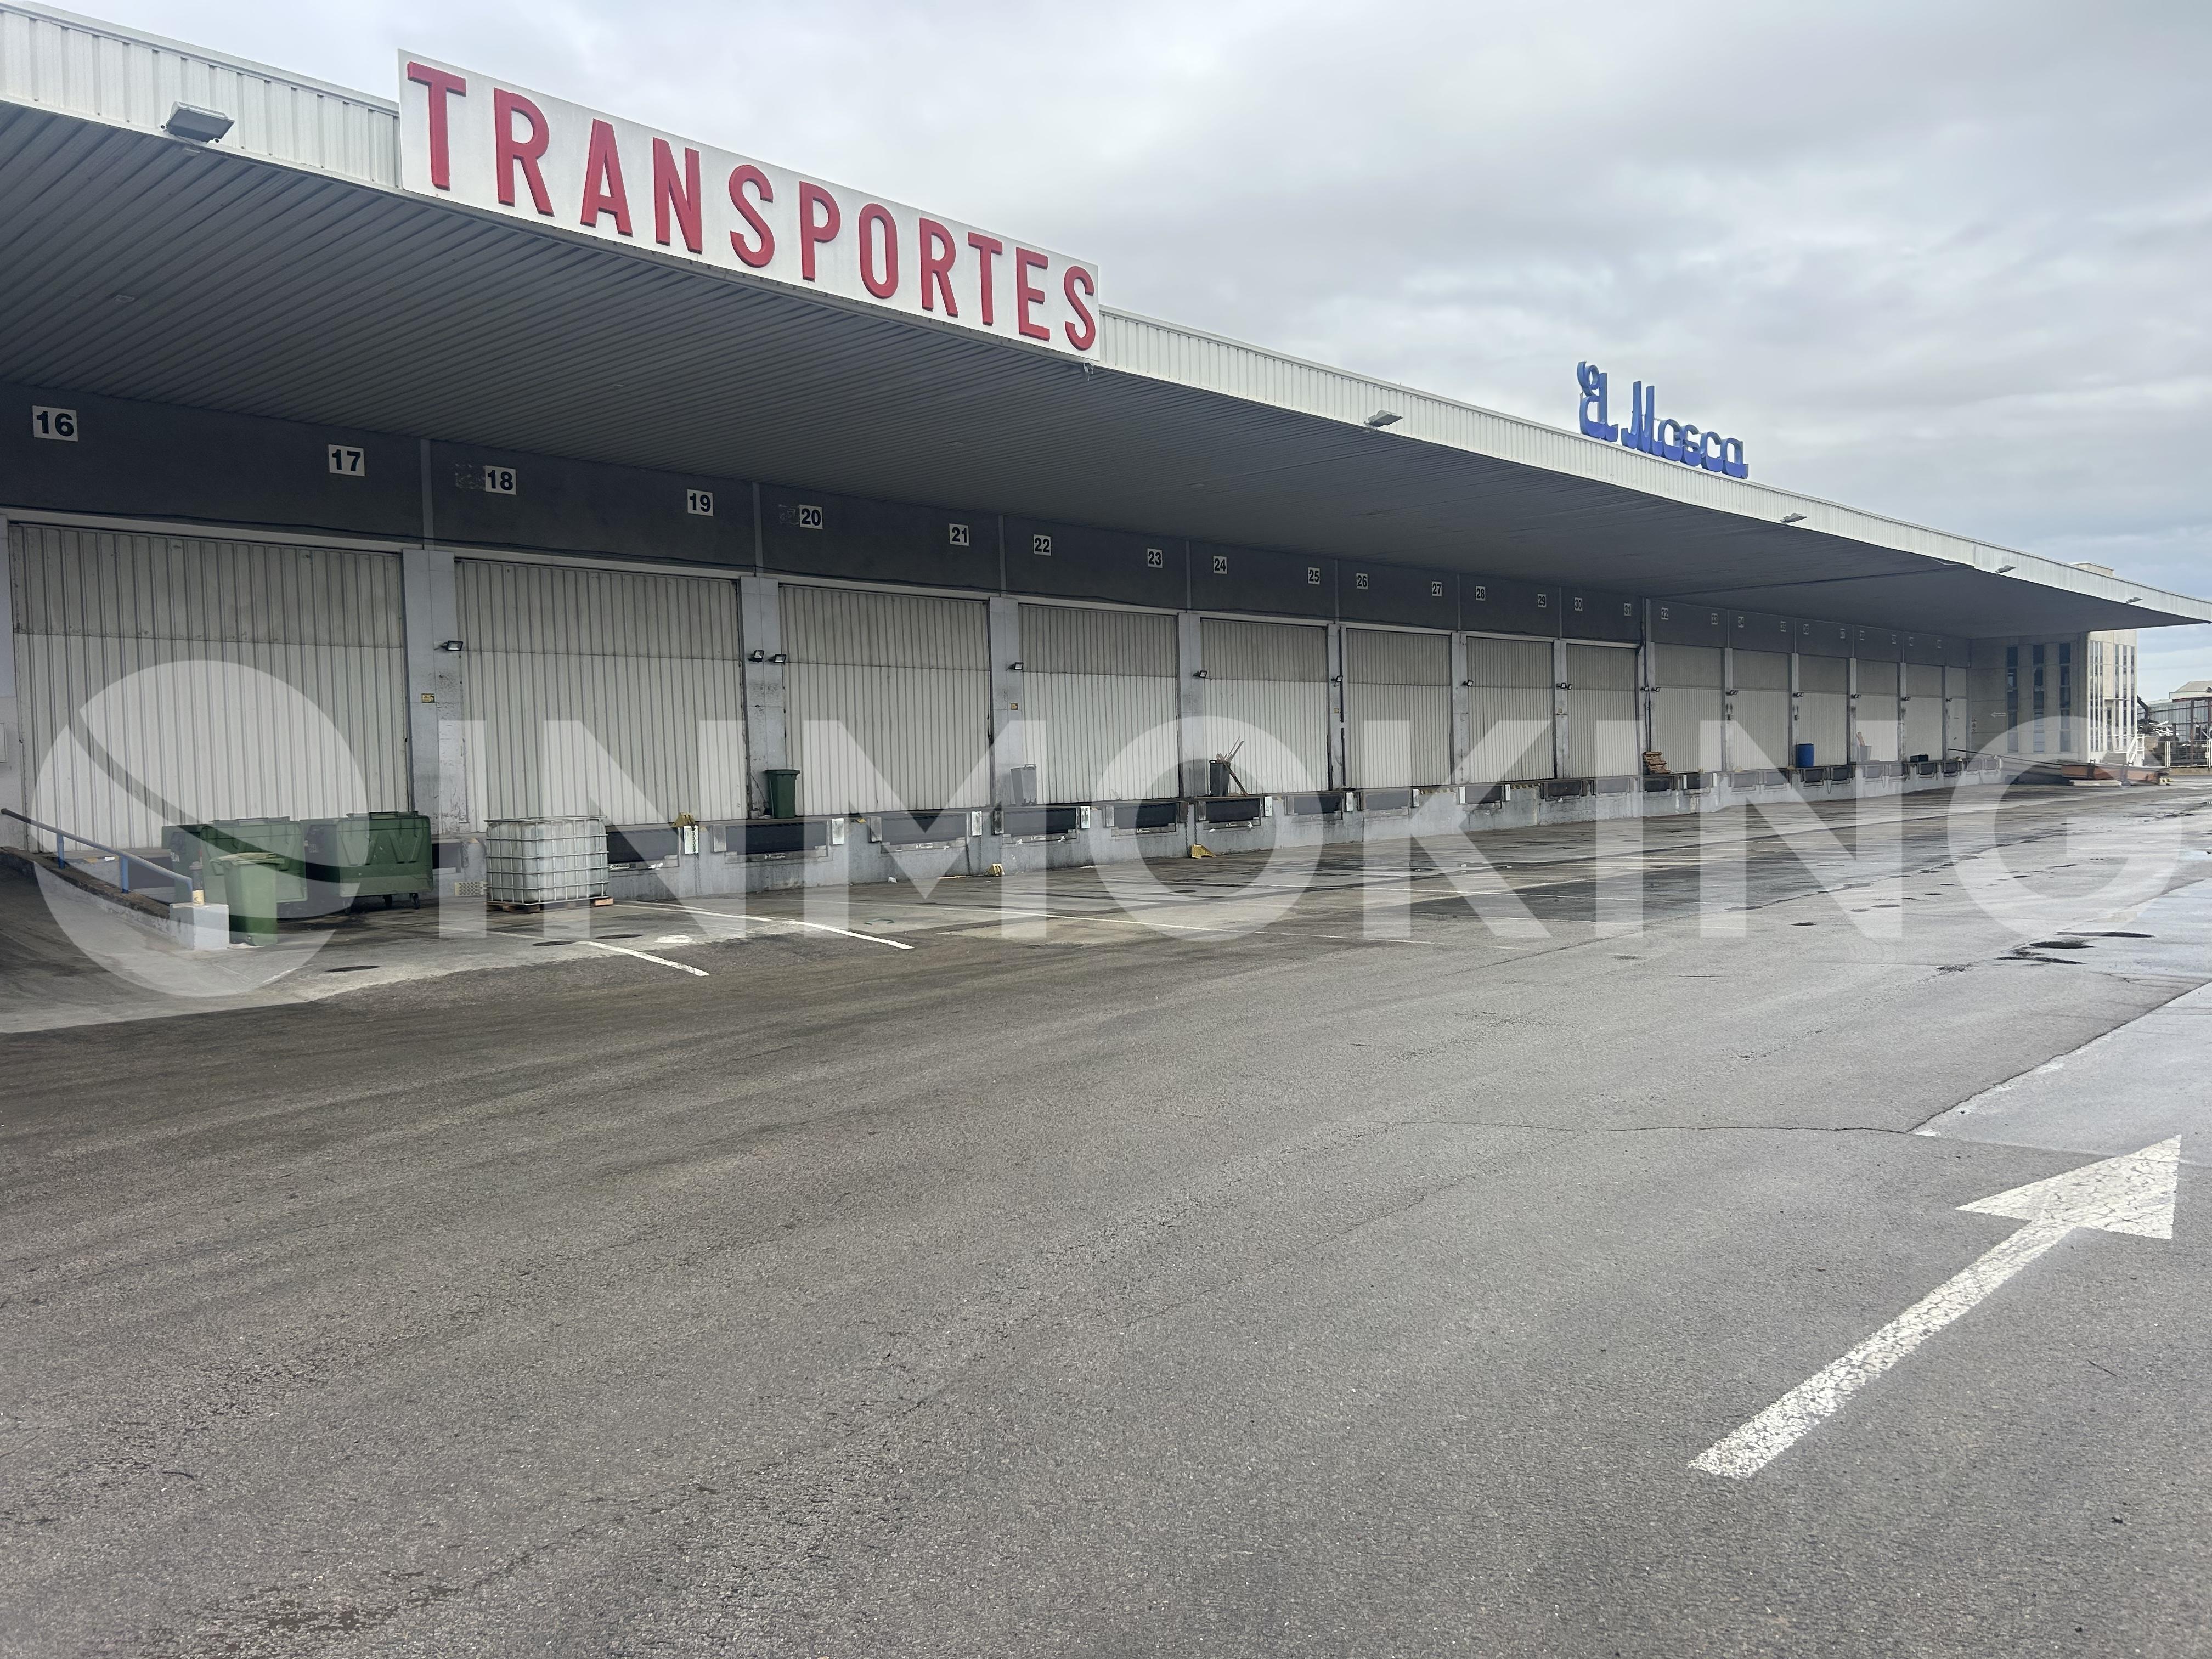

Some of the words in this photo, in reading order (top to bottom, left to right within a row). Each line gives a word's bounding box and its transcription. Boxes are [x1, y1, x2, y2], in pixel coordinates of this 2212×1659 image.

[407, 61, 1096, 351] TRANSPORTES
[36, 410, 74, 437] 16
[332, 449, 361, 472] 17
[487, 469, 514, 491] 18
[689, 493, 711, 512] 19
[801, 508, 821, 527] 20
[952, 527, 968, 543] 21
[1034, 538, 1050, 553] 22
[1148, 551, 1162, 566] 23
[1214, 558, 1227, 572] 24
[1309, 570, 1320, 583] 25
[1357, 575, 1368, 588] 26
[1432, 584, 1442, 595] 27
[1476, 588, 1486, 600] 28
[1538, 596, 1547, 606] 29
[1575, 600, 1582, 610] 30
[1624, 605, 1632, 614] 31
[1661, 608, 1668, 619] 32
